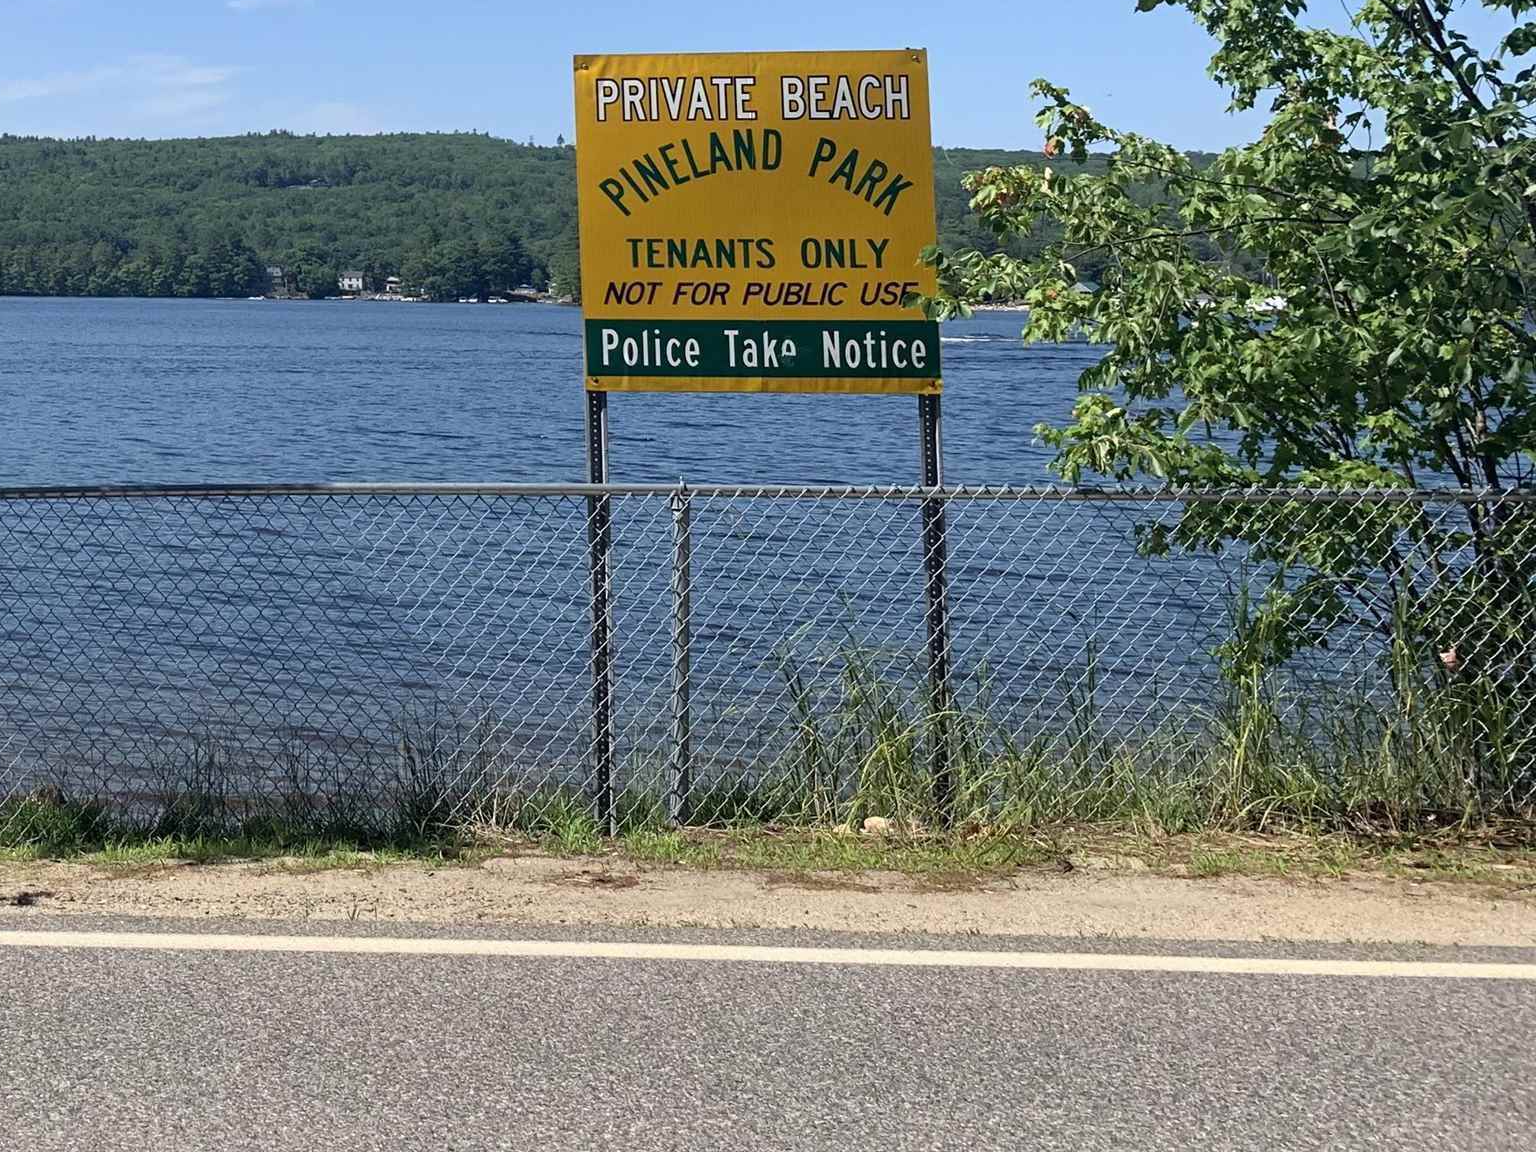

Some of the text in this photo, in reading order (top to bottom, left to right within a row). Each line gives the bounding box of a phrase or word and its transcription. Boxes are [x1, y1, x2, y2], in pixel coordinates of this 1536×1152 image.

[596, 75, 910, 122] PRIVATE BEACH
[599, 129, 913, 216] PINELAND PARK
[626, 237, 890, 269] TENANTS ONLY
[604, 282, 663, 305] NOT
[673, 282, 730, 305] FOR
[742, 282, 847, 306] PUBLIC
[601, 328, 700, 368] Police
[822, 330, 927, 369] Notice
